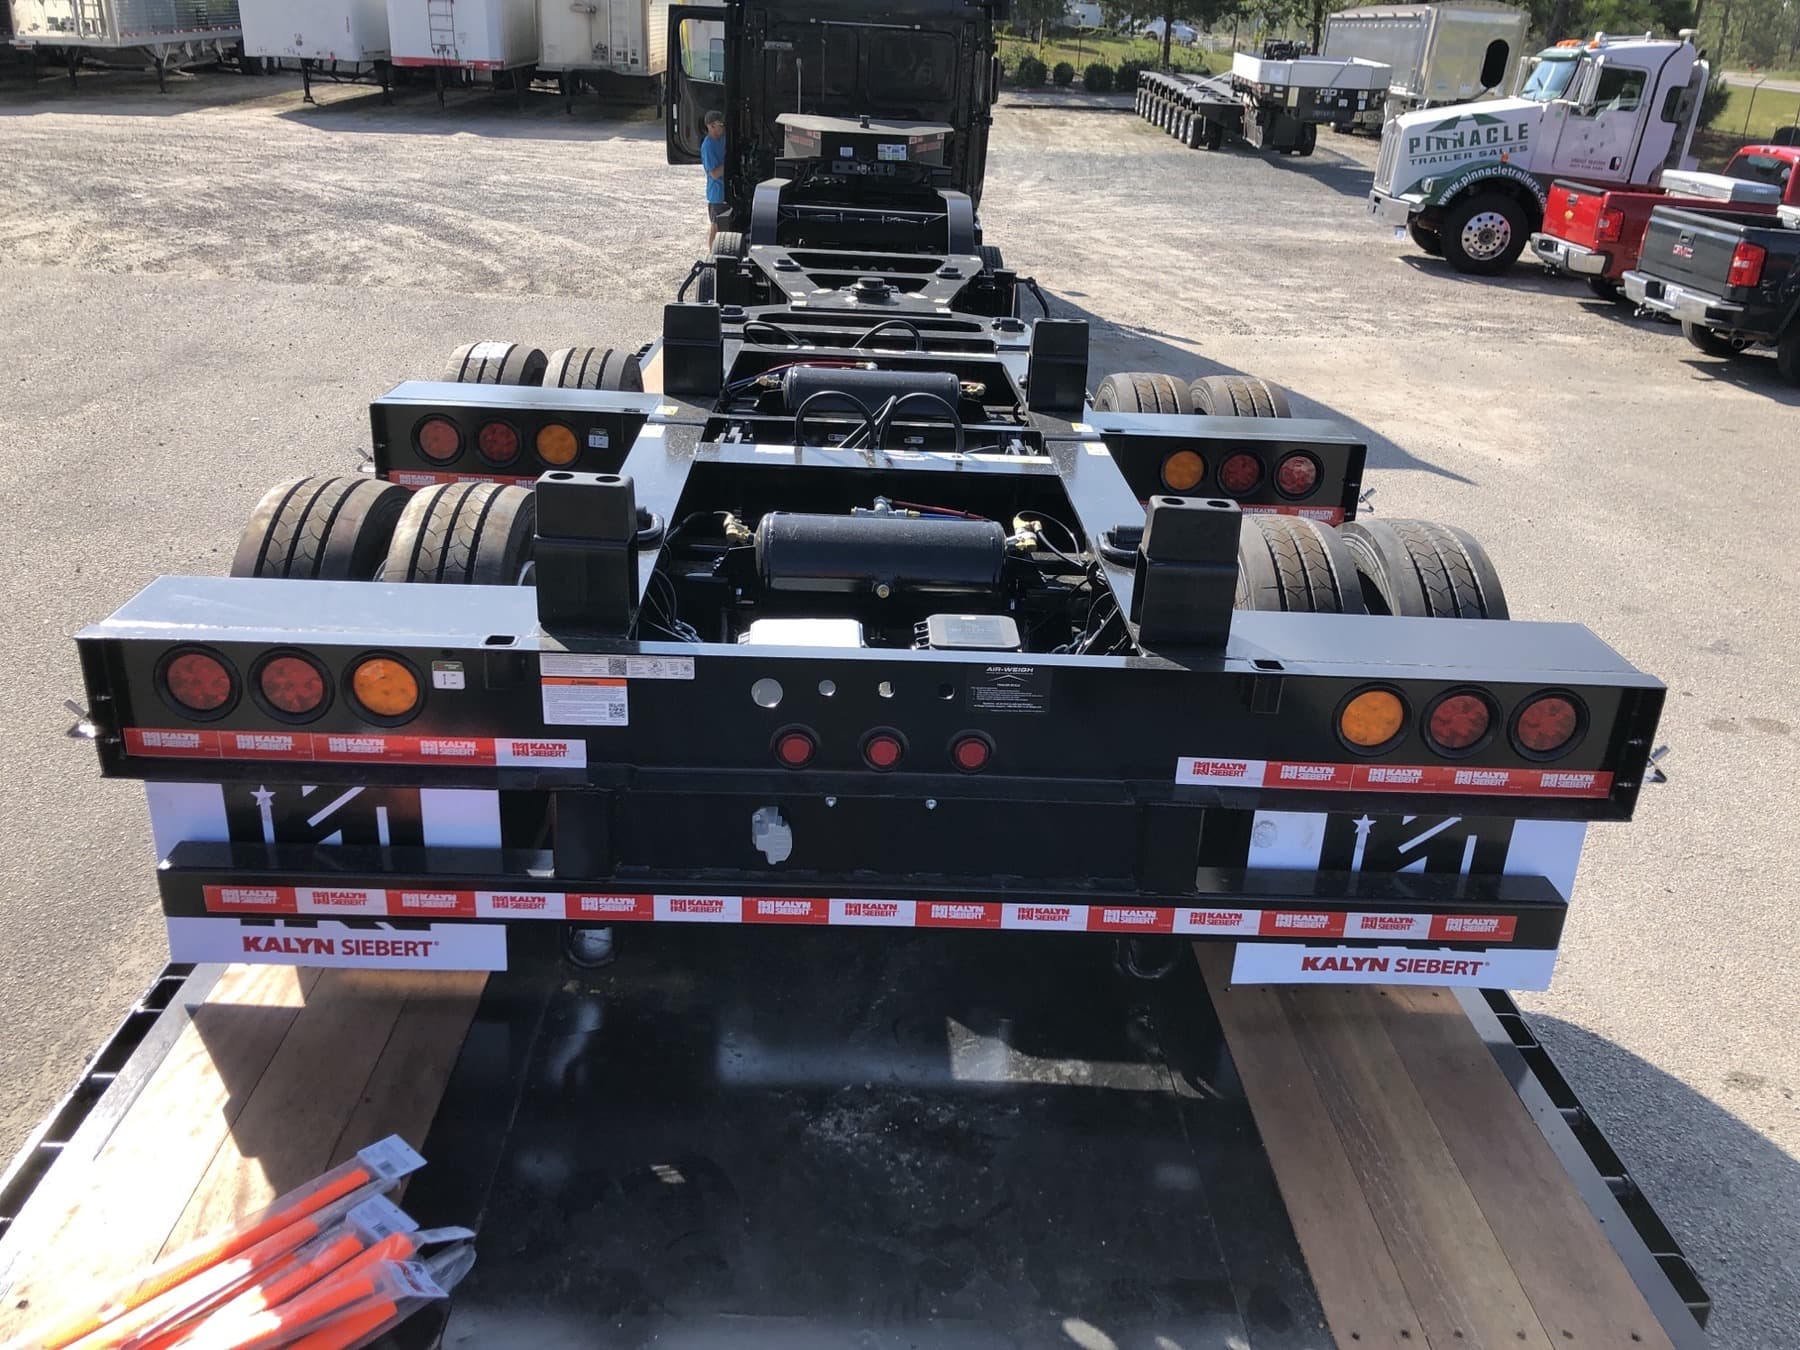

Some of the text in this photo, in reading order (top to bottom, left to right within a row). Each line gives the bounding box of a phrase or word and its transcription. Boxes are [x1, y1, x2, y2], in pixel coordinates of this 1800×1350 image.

[1409, 123, 1528, 154] PINNACLE
[1410, 145, 1528, 166] TRAILER SALES
[1438, 166, 1546, 208] www.pinnacletrailers.co
[347, 738, 384, 746] KALYN
[439, 740, 476, 748] KALYN
[1386, 769, 1422, 777] KALYN
[1473, 771, 1509, 779] KALYN
[1559, 774, 1594, 782] KALYN
[242, 936, 432, 957] KALYN SIEBERT
[1301, 956, 1484, 976] KALYN SIEBERT
